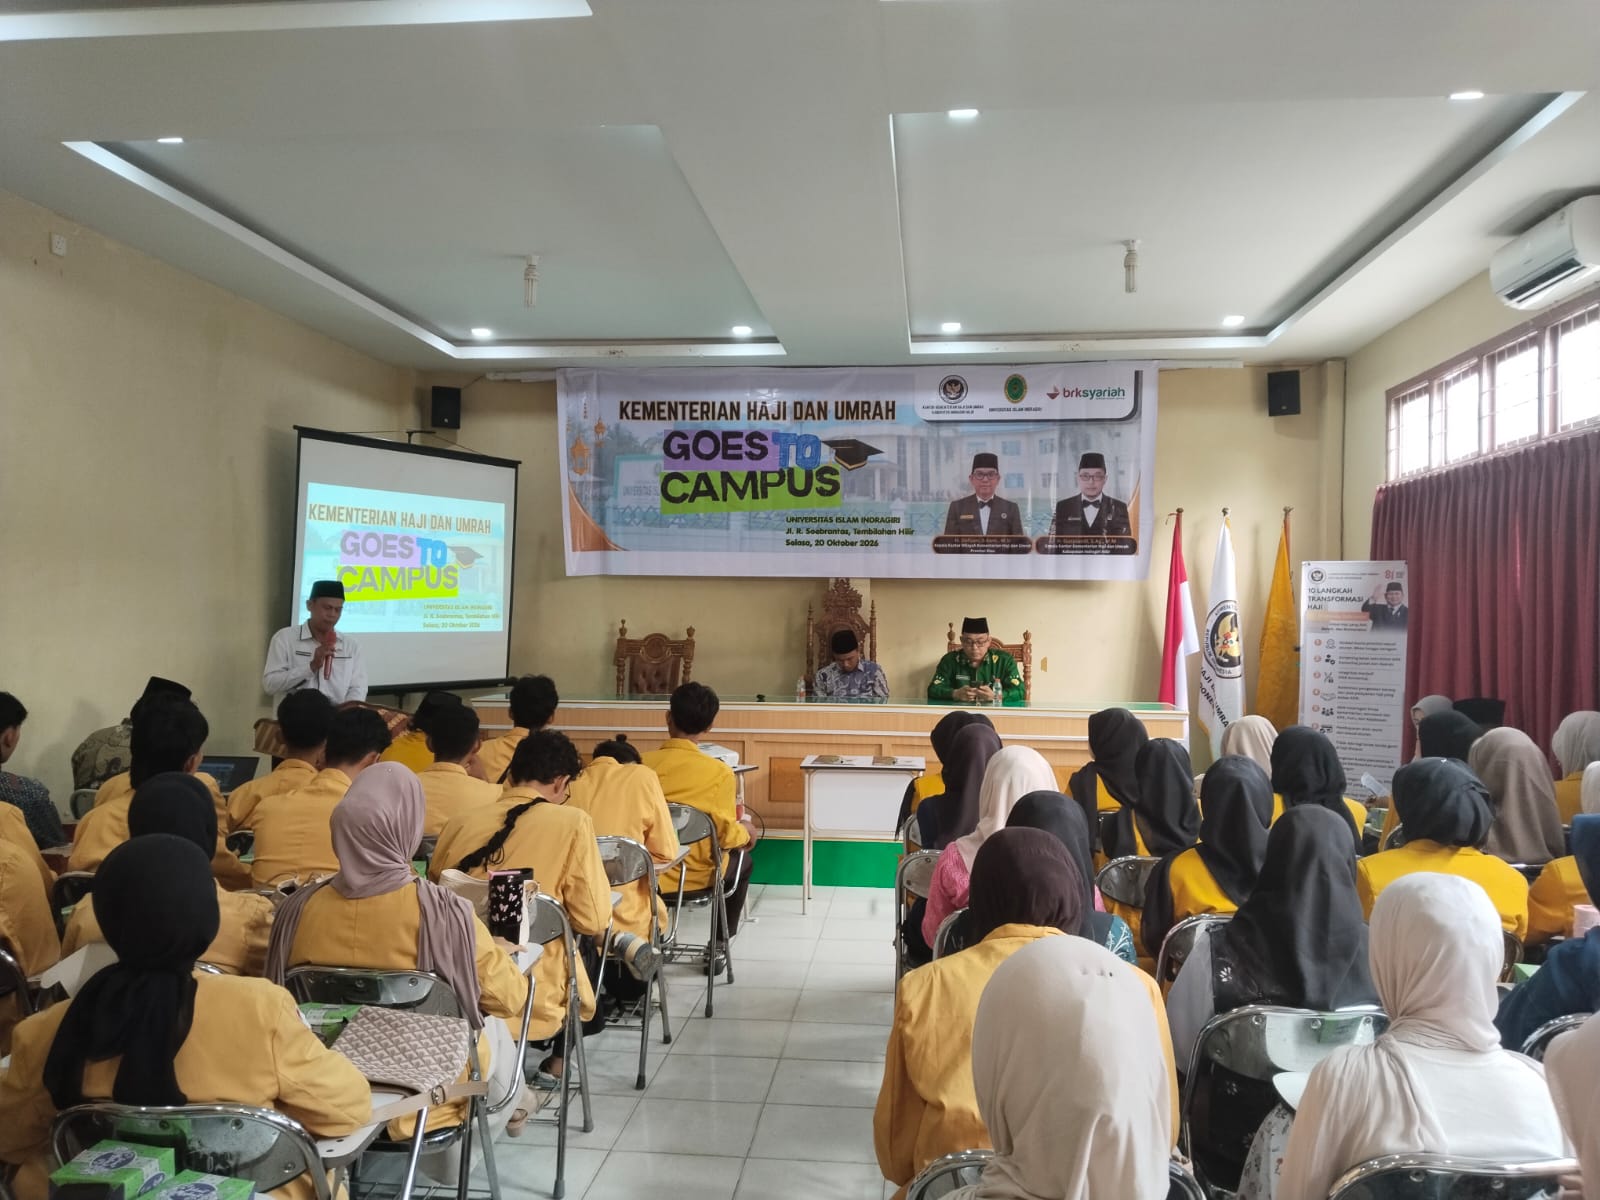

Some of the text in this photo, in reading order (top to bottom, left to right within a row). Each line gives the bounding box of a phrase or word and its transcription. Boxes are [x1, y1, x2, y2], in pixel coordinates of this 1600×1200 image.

[1063, 387, 1125, 400] brksyariah
[619, 401, 896, 420] KEMENTERIAN HAJI DAN UMRAH
[663, 430, 821, 470] GOES TO
[661, 466, 840, 504] CAMPUS
[308, 503, 491, 534] KEMENTERIAN HAJI DAN UMRAH
[786, 516, 834, 524] UNIVERSITAS
[835, 516, 859, 524] ISLAM
[340, 531, 447, 568] GOES TO
[814, 539, 825, 547] 20
[826, 539, 858, 547] Oktober
[338, 565, 459, 593] CAMPUS
